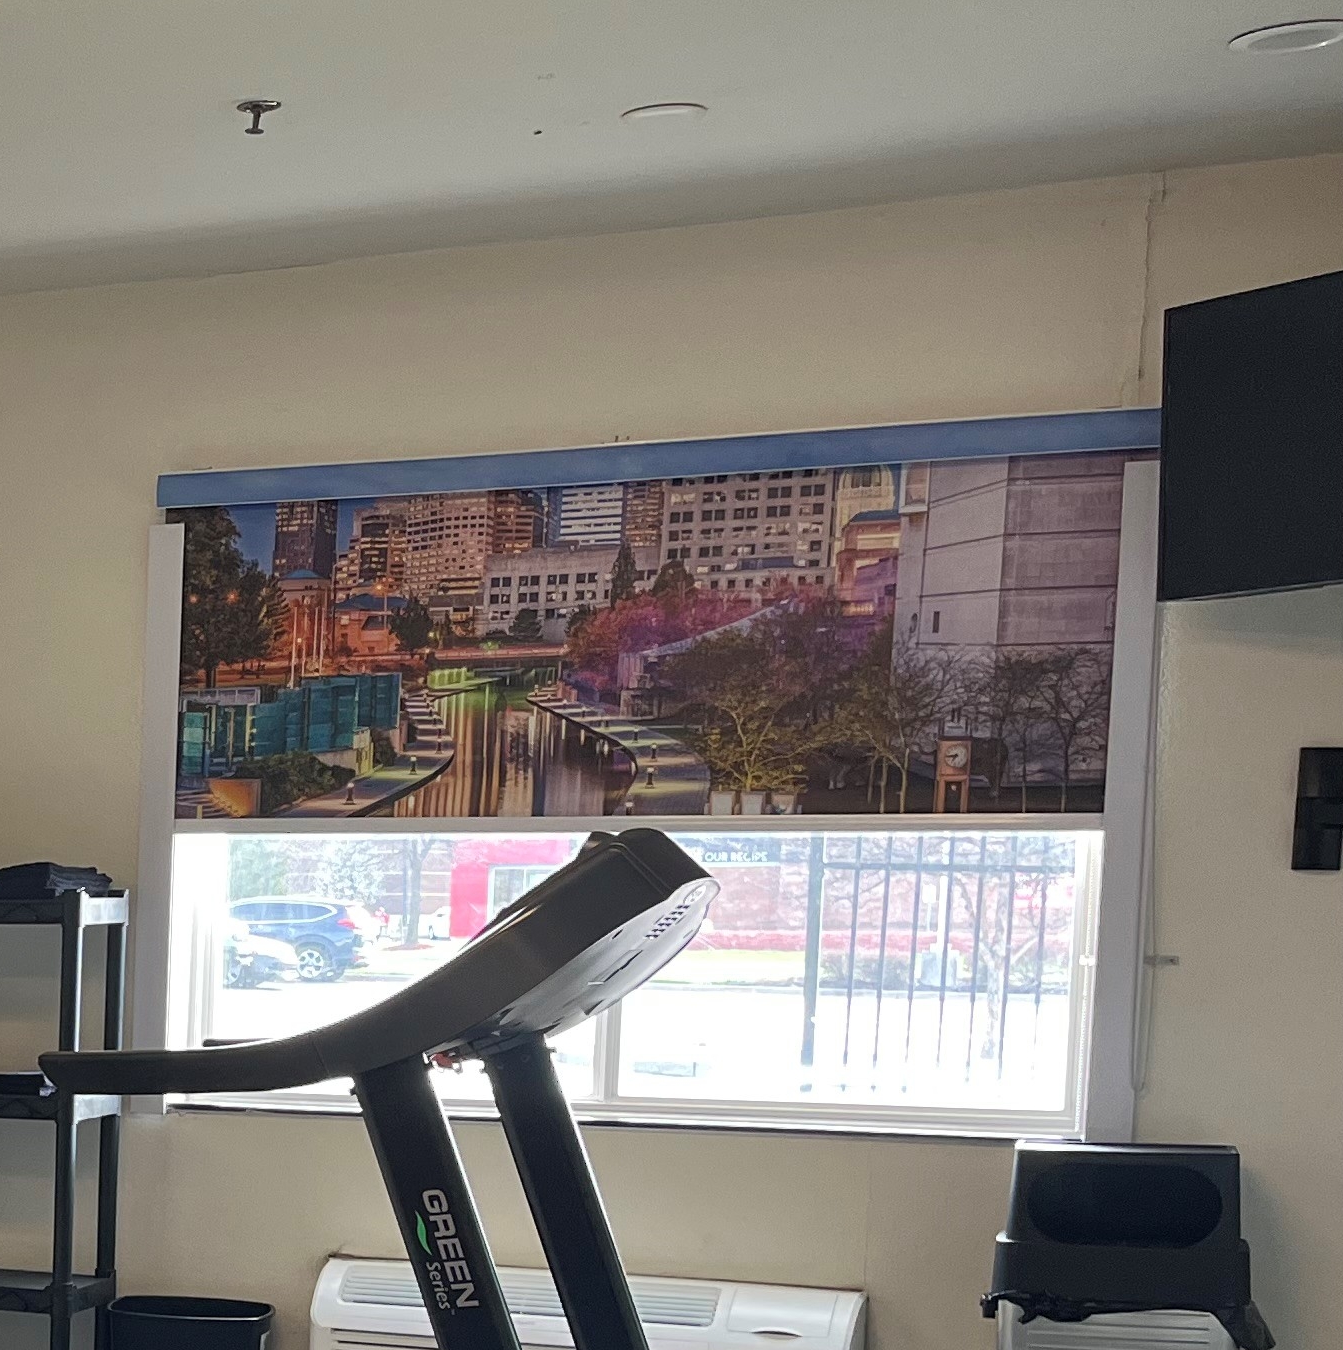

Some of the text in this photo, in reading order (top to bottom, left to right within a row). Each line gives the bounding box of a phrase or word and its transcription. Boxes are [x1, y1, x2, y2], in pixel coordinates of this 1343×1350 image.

[705, 851, 728, 862] OUR
[422, 1189, 479, 1308] GREEN
[426, 1262, 451, 1311] Series
